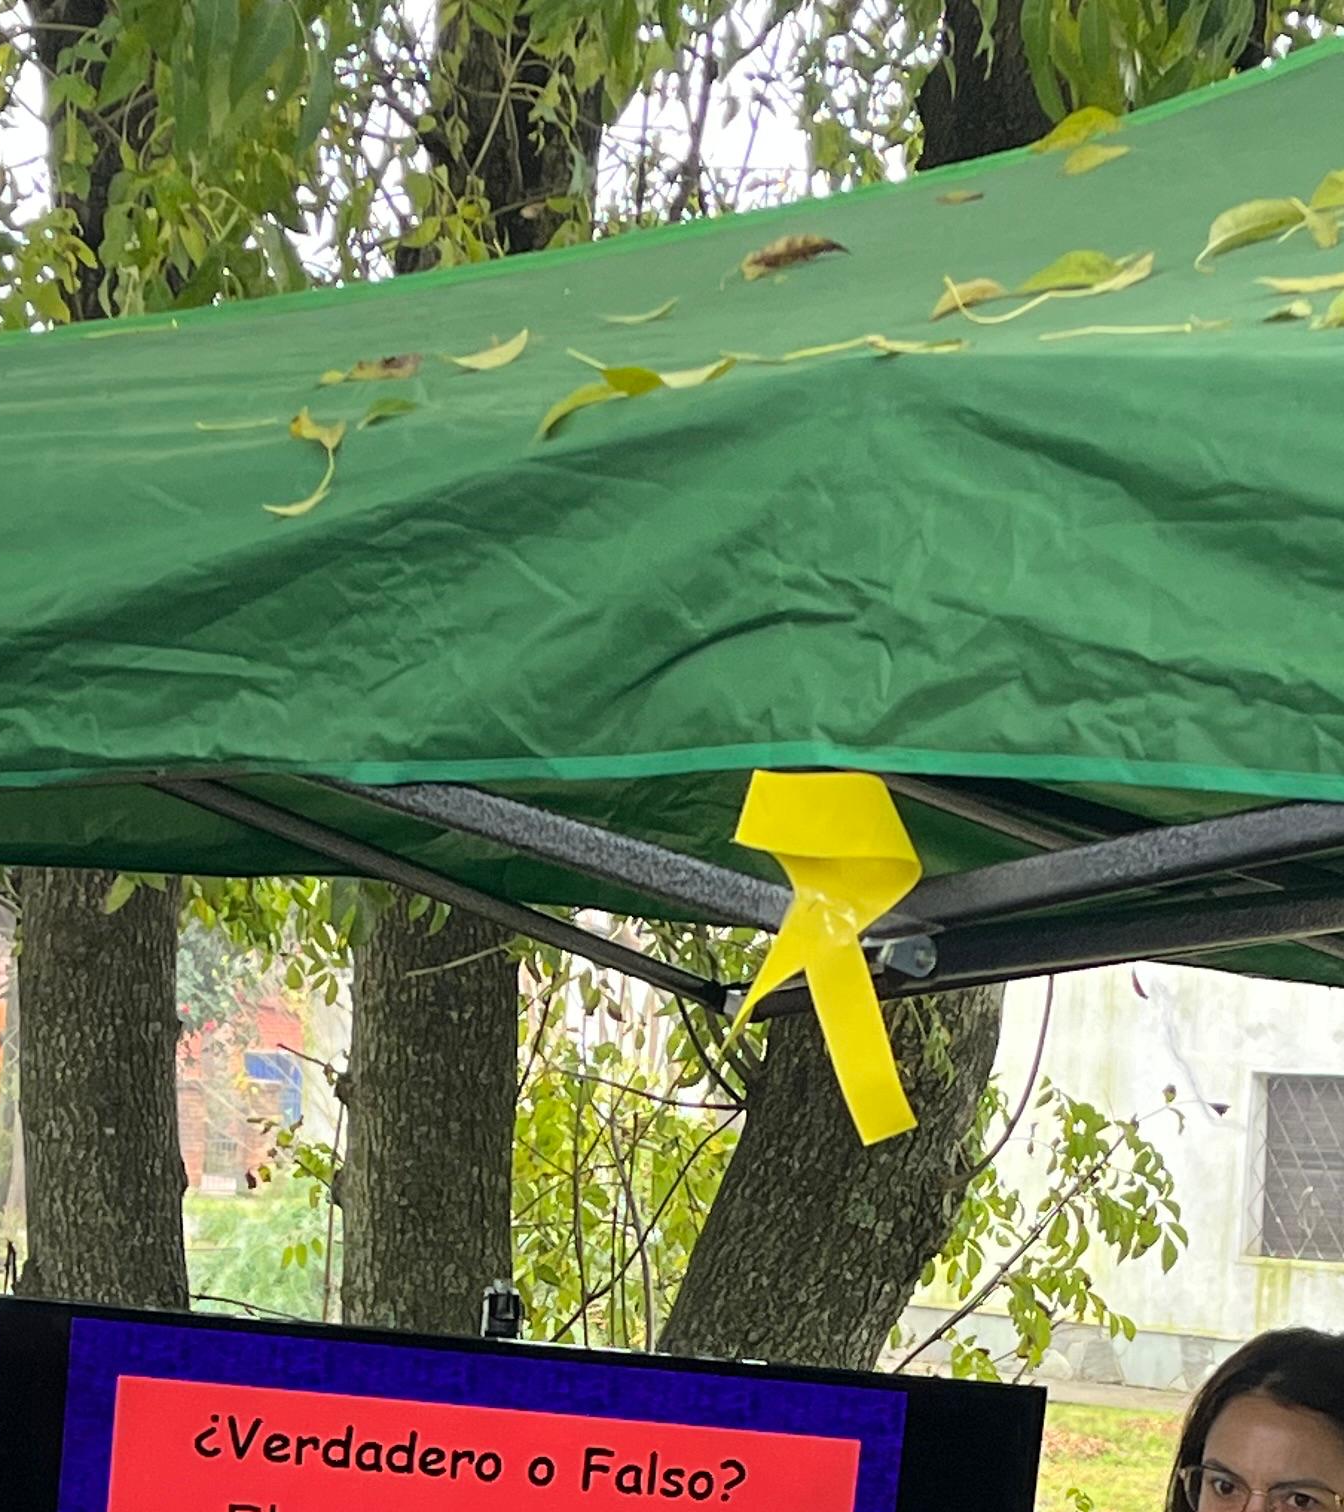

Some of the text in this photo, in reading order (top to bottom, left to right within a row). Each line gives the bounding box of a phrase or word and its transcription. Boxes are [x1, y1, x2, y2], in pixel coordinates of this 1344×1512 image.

[195, 1415, 745, 1501] ¿Verdadero o Falso?
